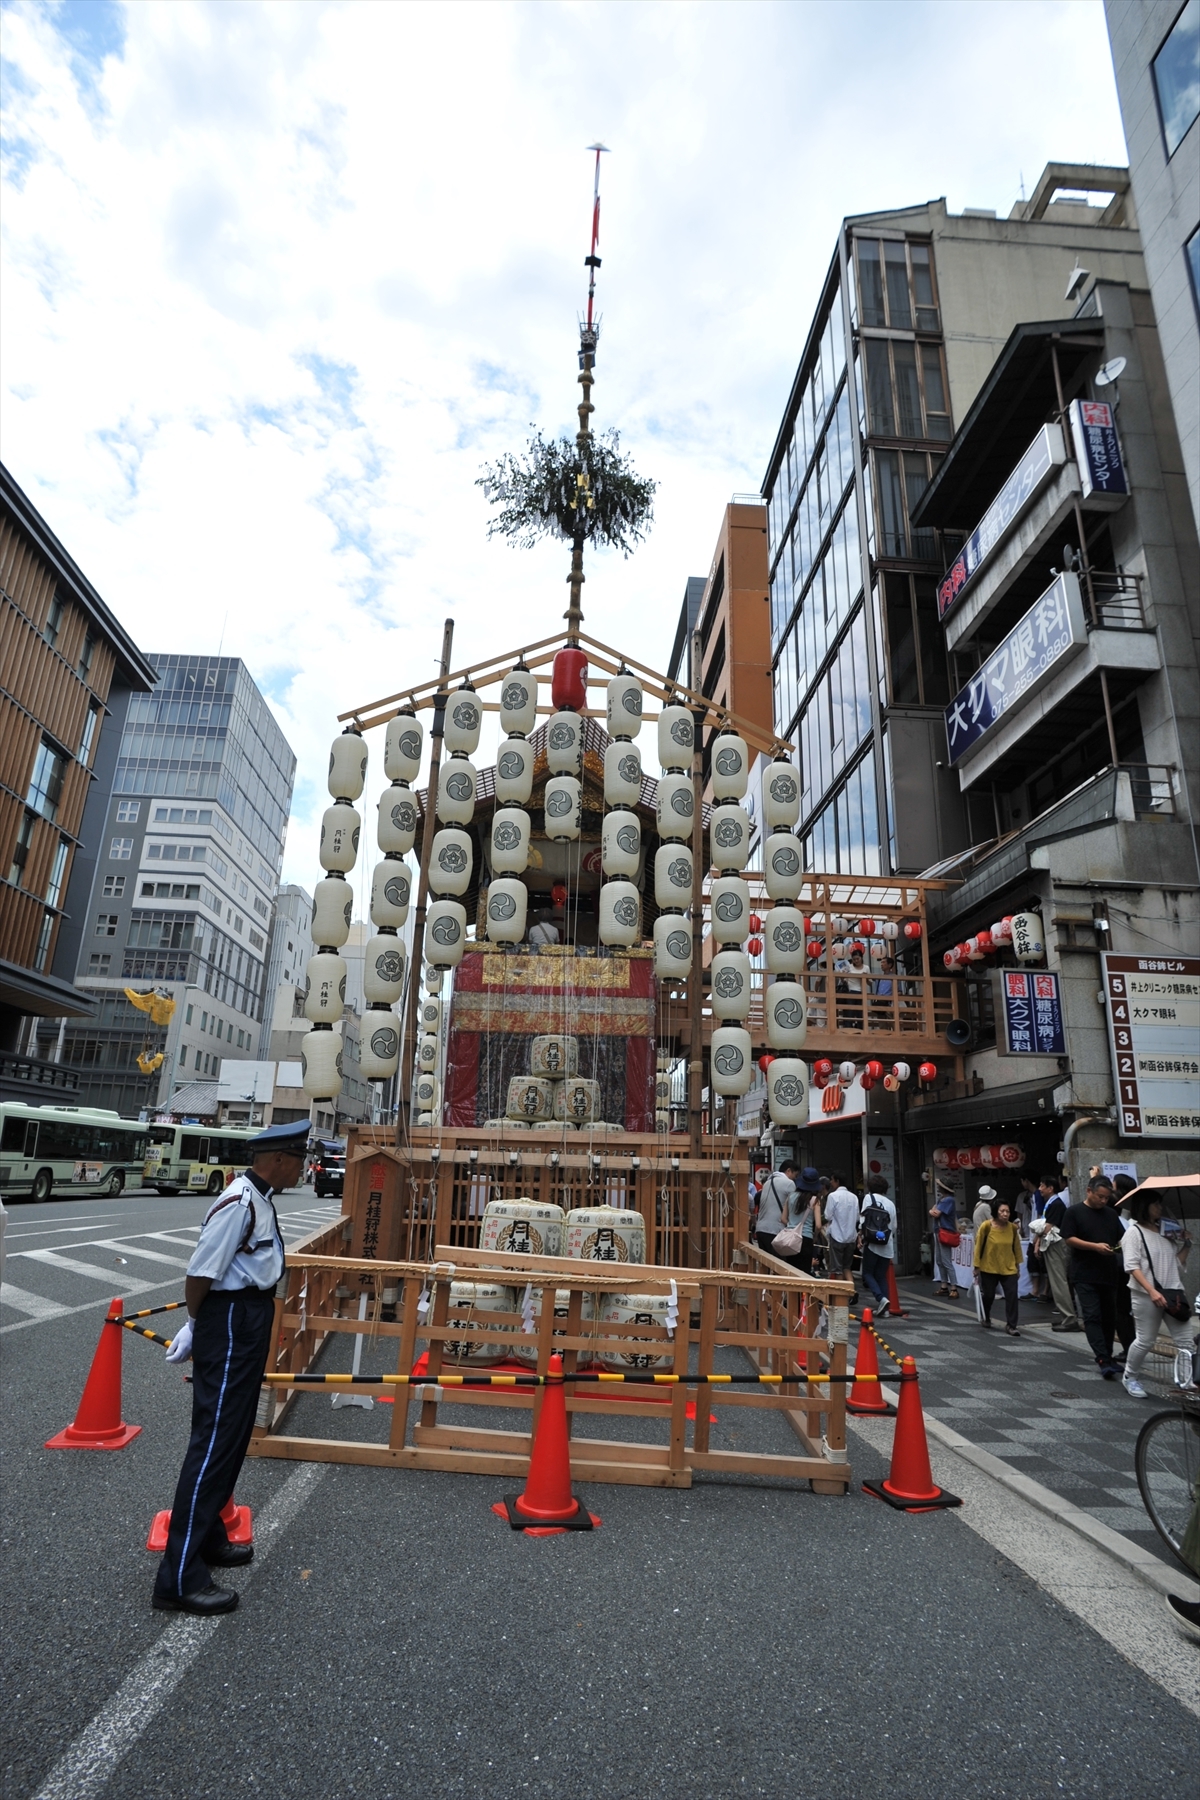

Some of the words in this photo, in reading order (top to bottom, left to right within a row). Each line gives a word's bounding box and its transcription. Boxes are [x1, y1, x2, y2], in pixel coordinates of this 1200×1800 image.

[1083, 402, 1110, 427] 内科
[1087, 427, 1110, 490] 糖尿病センター
[939, 555, 967, 614] 内科
[948, 586, 1065, 747] 大クマ眼科
[990, 630, 1070, 719] 075-255-0880
[1013, 915, 1032, 955] 函谷鉾
[1138, 960, 1186, 972] 函谷鉾ビル
[1008, 974, 1026, 997] 眼科
[1036, 975, 1054, 998] 内科
[1112, 979, 1124, 993] 5
[1009, 998, 1032, 1052] 大クマ眼科
[1036, 1000, 1054, 1053] 糖尿病センター
[1115, 1005, 1126, 1019] 4
[1133, 1007, 1177, 1020] 大クマ眼科
[1118, 1031, 1129, 1046] 3
[546, 1042, 560, 1071] 月桂冠
[1120, 1058, 1132, 1073] 2
[524, 1085, 538, 1115] 月桂冠
[573, 1086, 587, 1117] 月桂冠
[1125, 1085, 1133, 1100] 1
[358, 1191, 382, 1286] 月桂冠株式社
